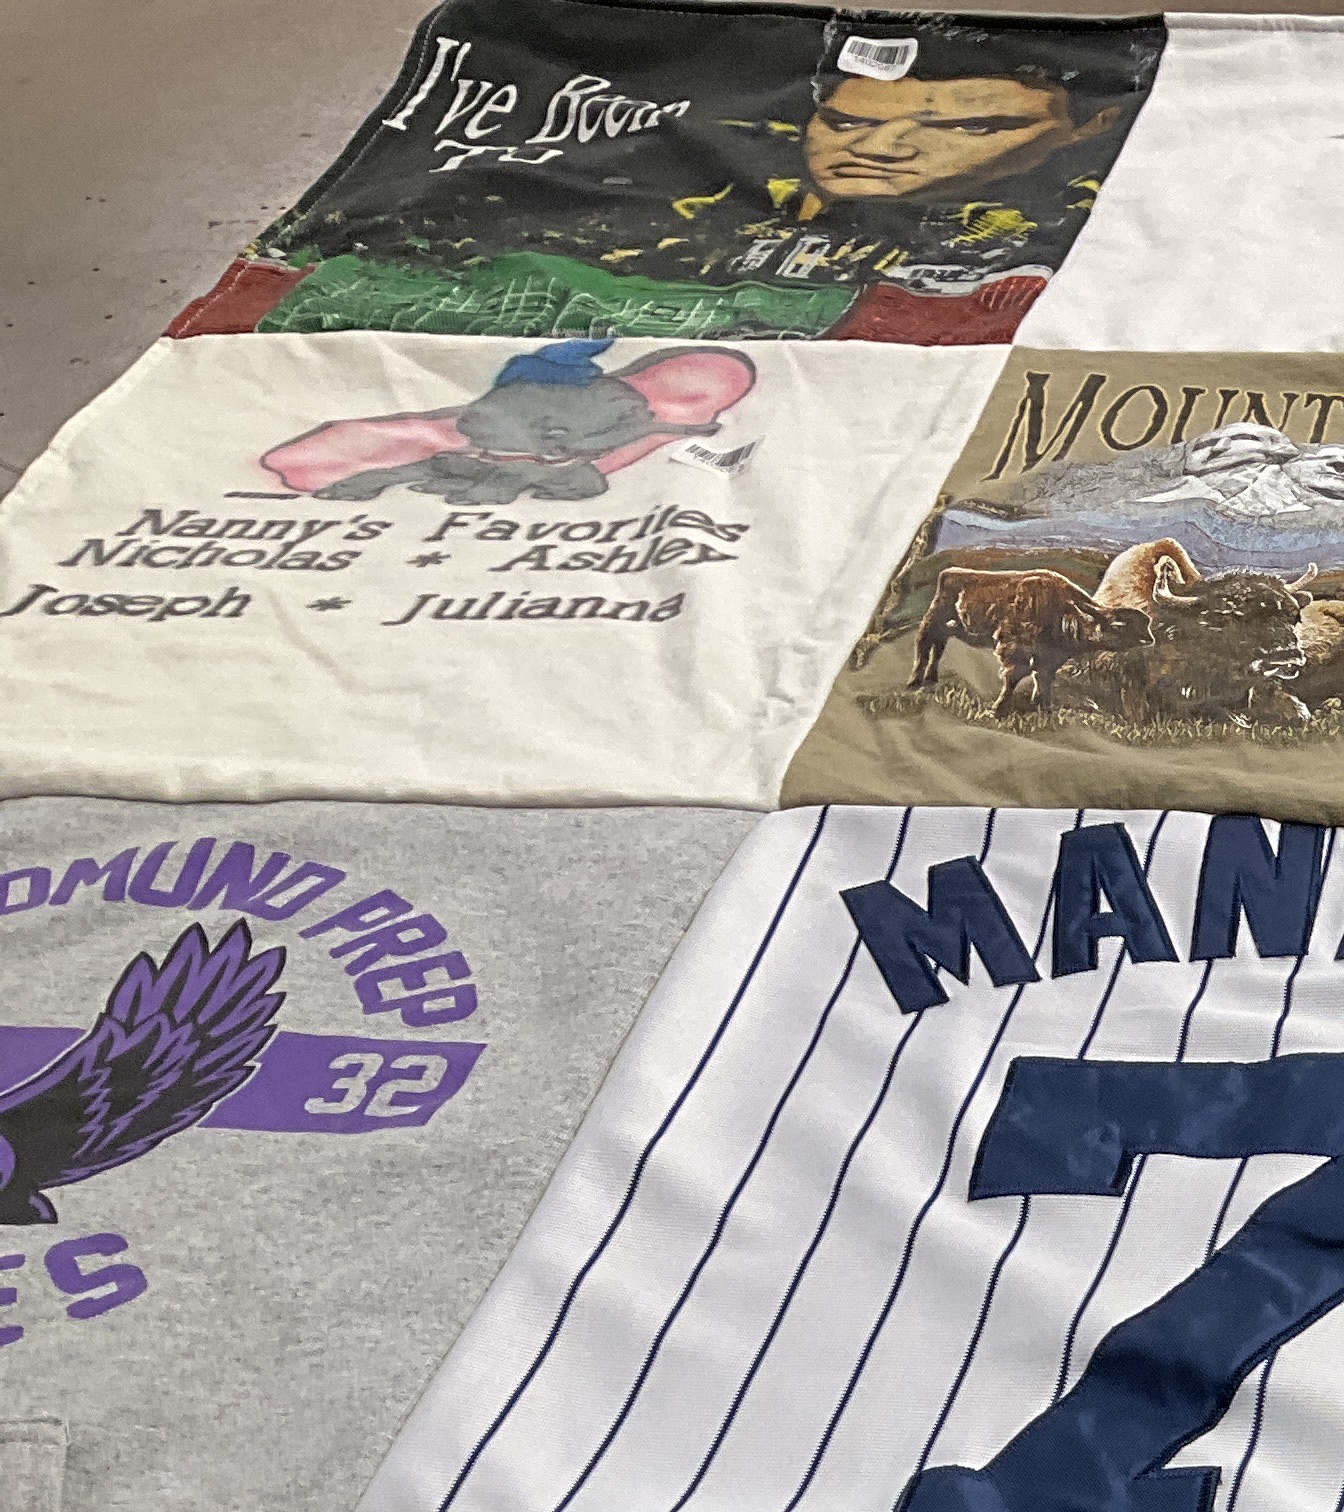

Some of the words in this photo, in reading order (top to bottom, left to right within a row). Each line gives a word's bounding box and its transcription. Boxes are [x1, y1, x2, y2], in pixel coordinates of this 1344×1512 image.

[382, 36, 519, 140] I've
[429, 139, 563, 172] To
[115, 508, 393, 551] Nanny's
[421, 504, 750, 543] Favorites
[57, 538, 363, 572] Nicholas
[0, 583, 253, 622] Joseph
[380, 590, 687, 627] Julianna
[298, 888, 479, 1028] PREP
[304, 1052, 448, 1118] 32
